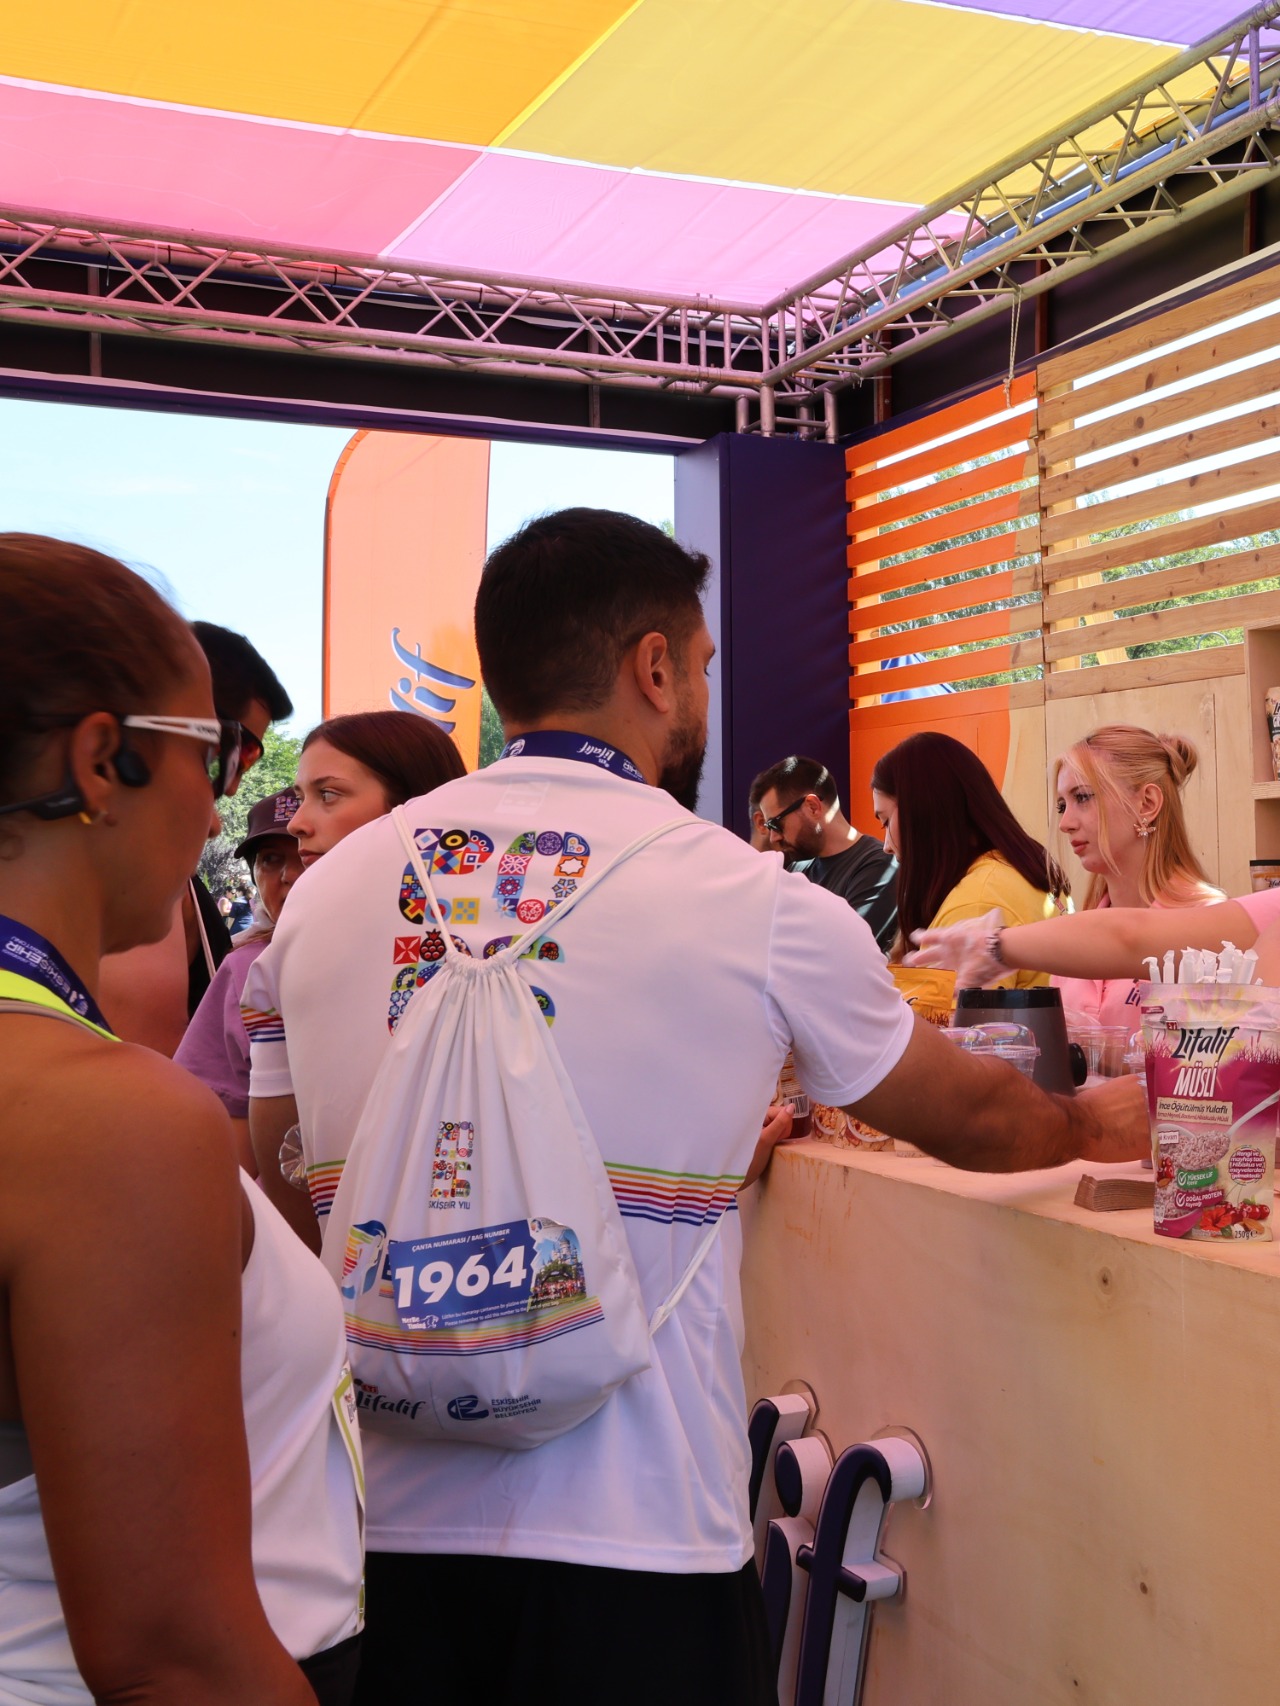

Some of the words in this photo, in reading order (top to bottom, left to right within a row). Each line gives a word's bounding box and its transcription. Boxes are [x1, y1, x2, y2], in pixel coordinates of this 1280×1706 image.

[1171, 1026, 1239, 1062] Lifalif
[1173, 1061, 1219, 1098] MÜSLİ
[1186, 1194, 1202, 1202] DOĞAL
[412, 1242, 432, 1253] ÇANTA
[433, 1236, 466, 1249] NUMARASI
[471, 1233, 483, 1242] BAG
[484, 1228, 510, 1239] NUMBER
[395, 1245, 527, 1309] 1964
[356, 1390, 426, 1420] Lifalif
[491, 1395, 529, 1406] ESKİŞEHİR
